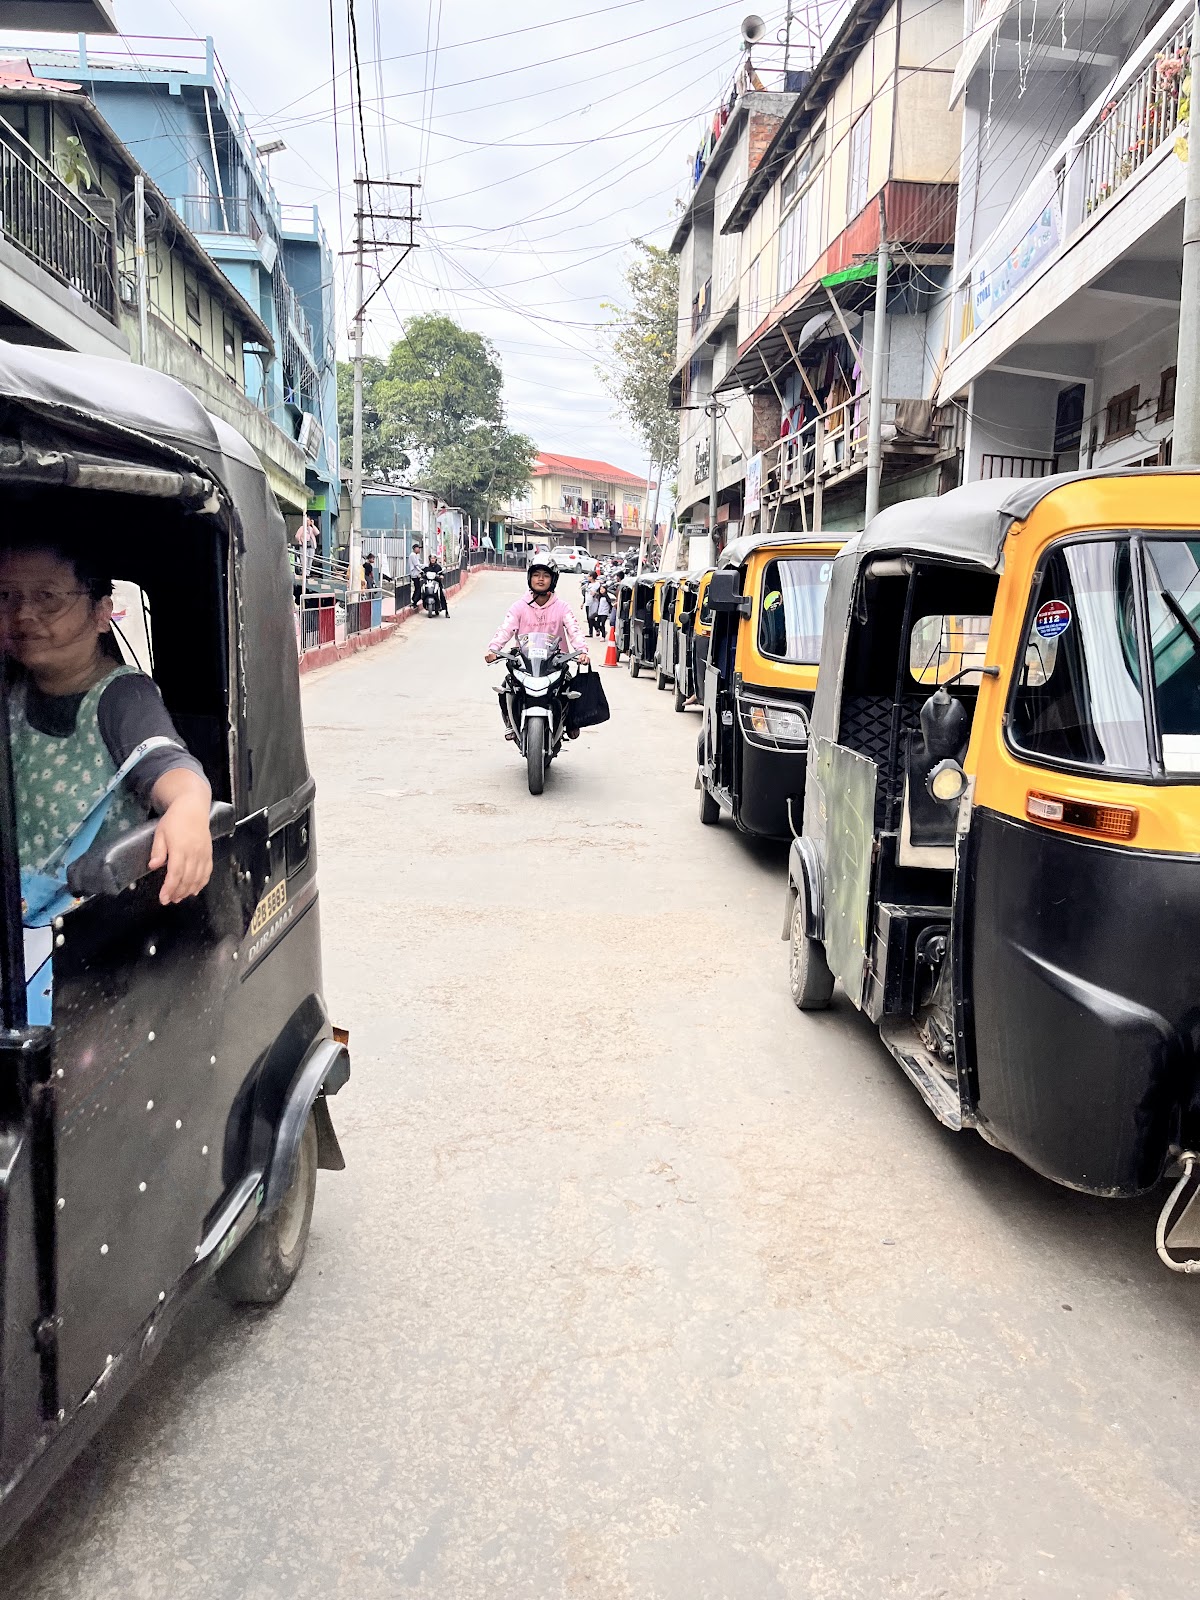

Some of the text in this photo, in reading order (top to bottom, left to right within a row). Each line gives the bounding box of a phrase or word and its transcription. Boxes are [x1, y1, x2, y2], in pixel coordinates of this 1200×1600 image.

[977, 283, 990, 307] STORE
[1043, 615, 1060, 625] 112
[248, 904, 294, 961] DURAMAX
